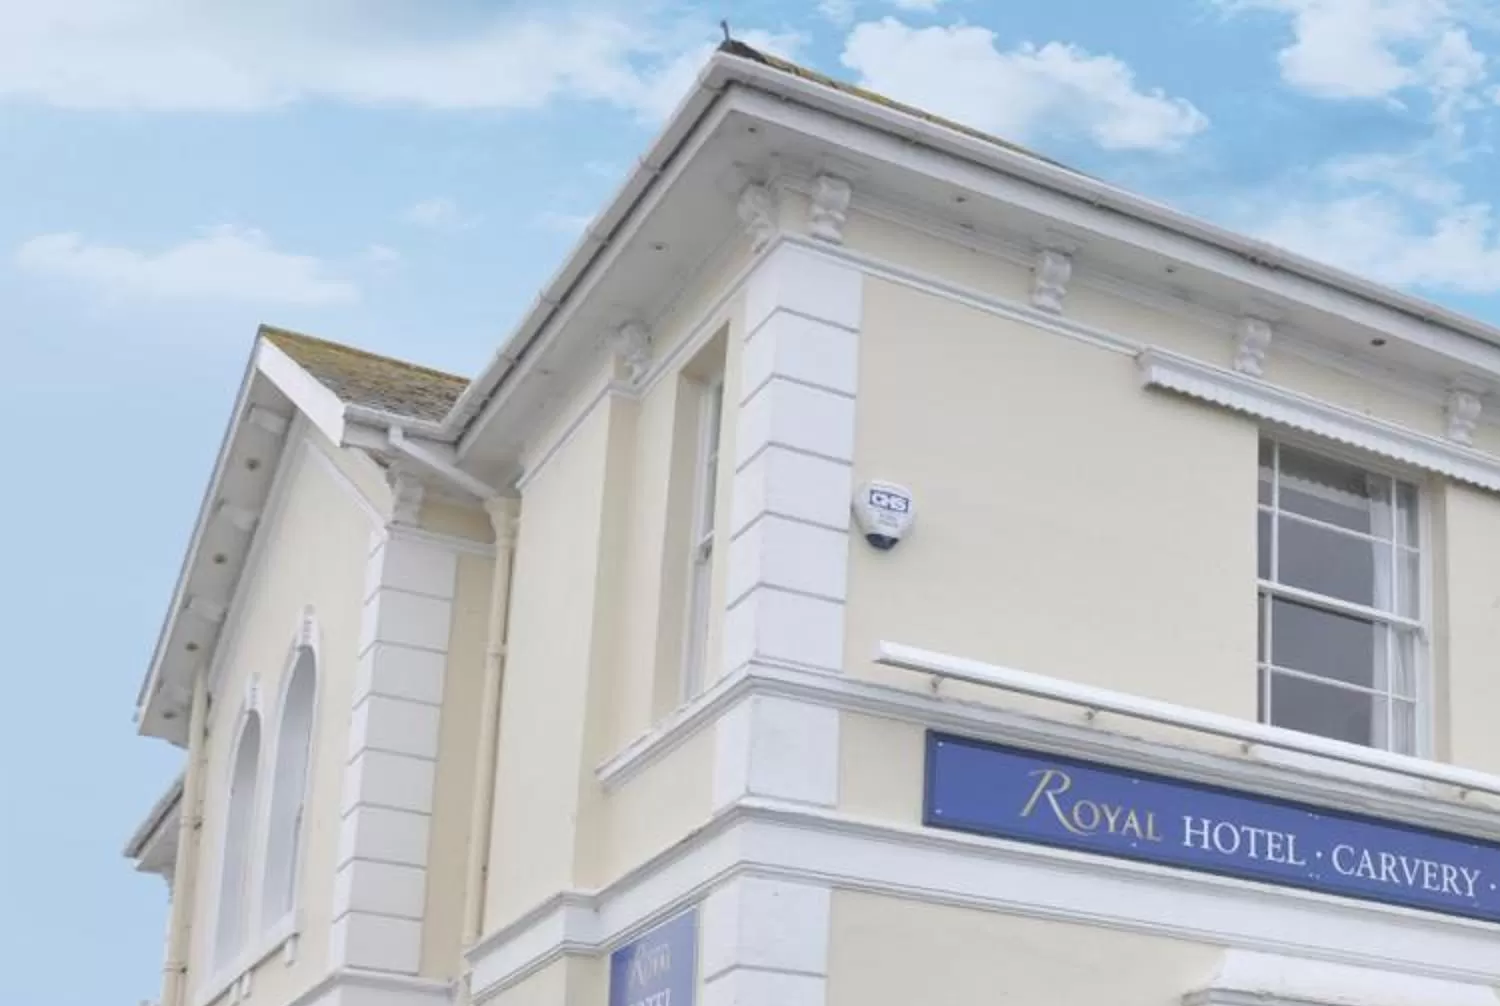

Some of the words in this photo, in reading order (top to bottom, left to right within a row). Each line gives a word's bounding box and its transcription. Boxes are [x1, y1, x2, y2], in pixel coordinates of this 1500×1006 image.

[1019, 768, 1162, 837] ROYAL
[1182, 814, 1306, 866] HOTEL
[1331, 844, 1481, 898] CARVERY
